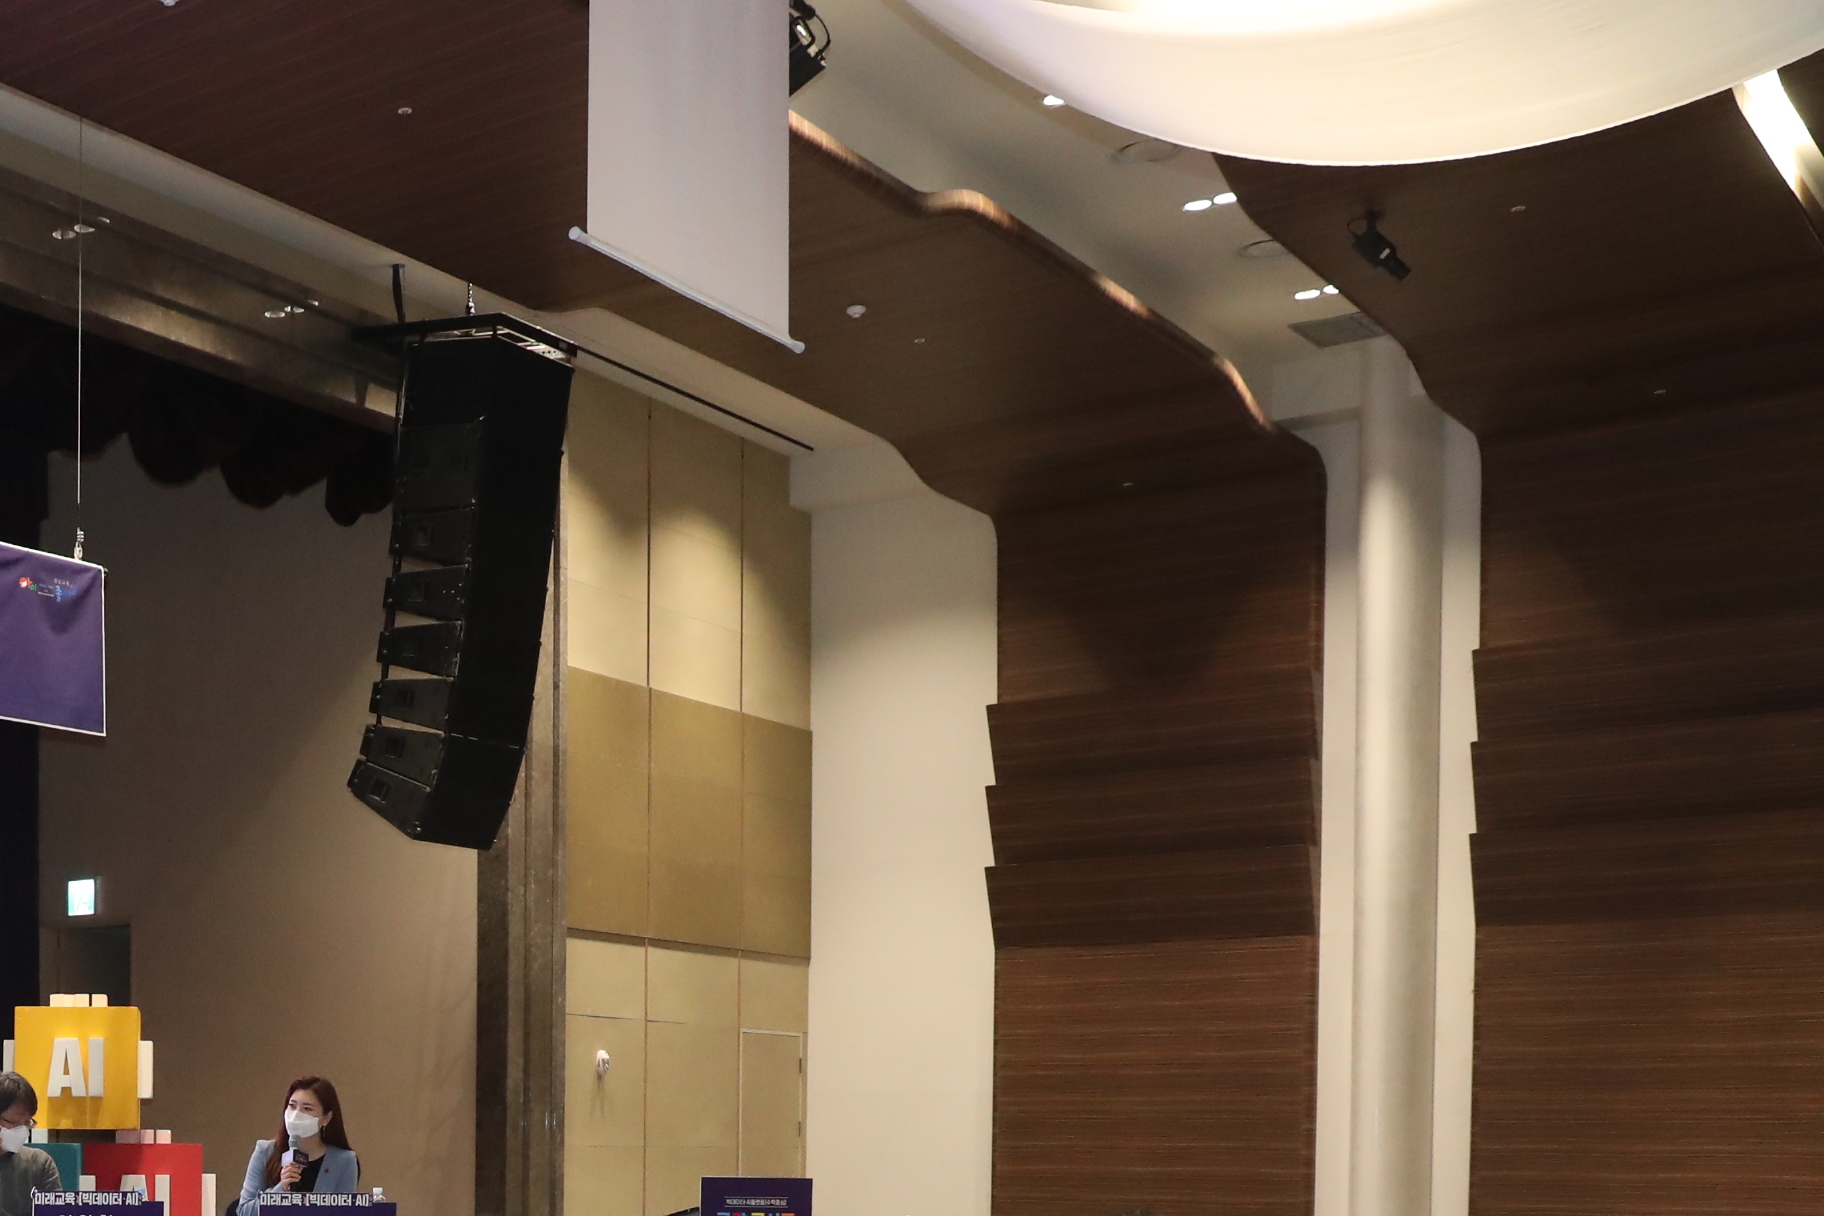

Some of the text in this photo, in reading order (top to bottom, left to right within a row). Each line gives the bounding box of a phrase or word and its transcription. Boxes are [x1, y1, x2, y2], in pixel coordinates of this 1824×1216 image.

[47, 1037, 104, 1097] AI
[35, 1192, 76, 1206] 미래교육
[260, 1194, 302, 1207] 미래교육
